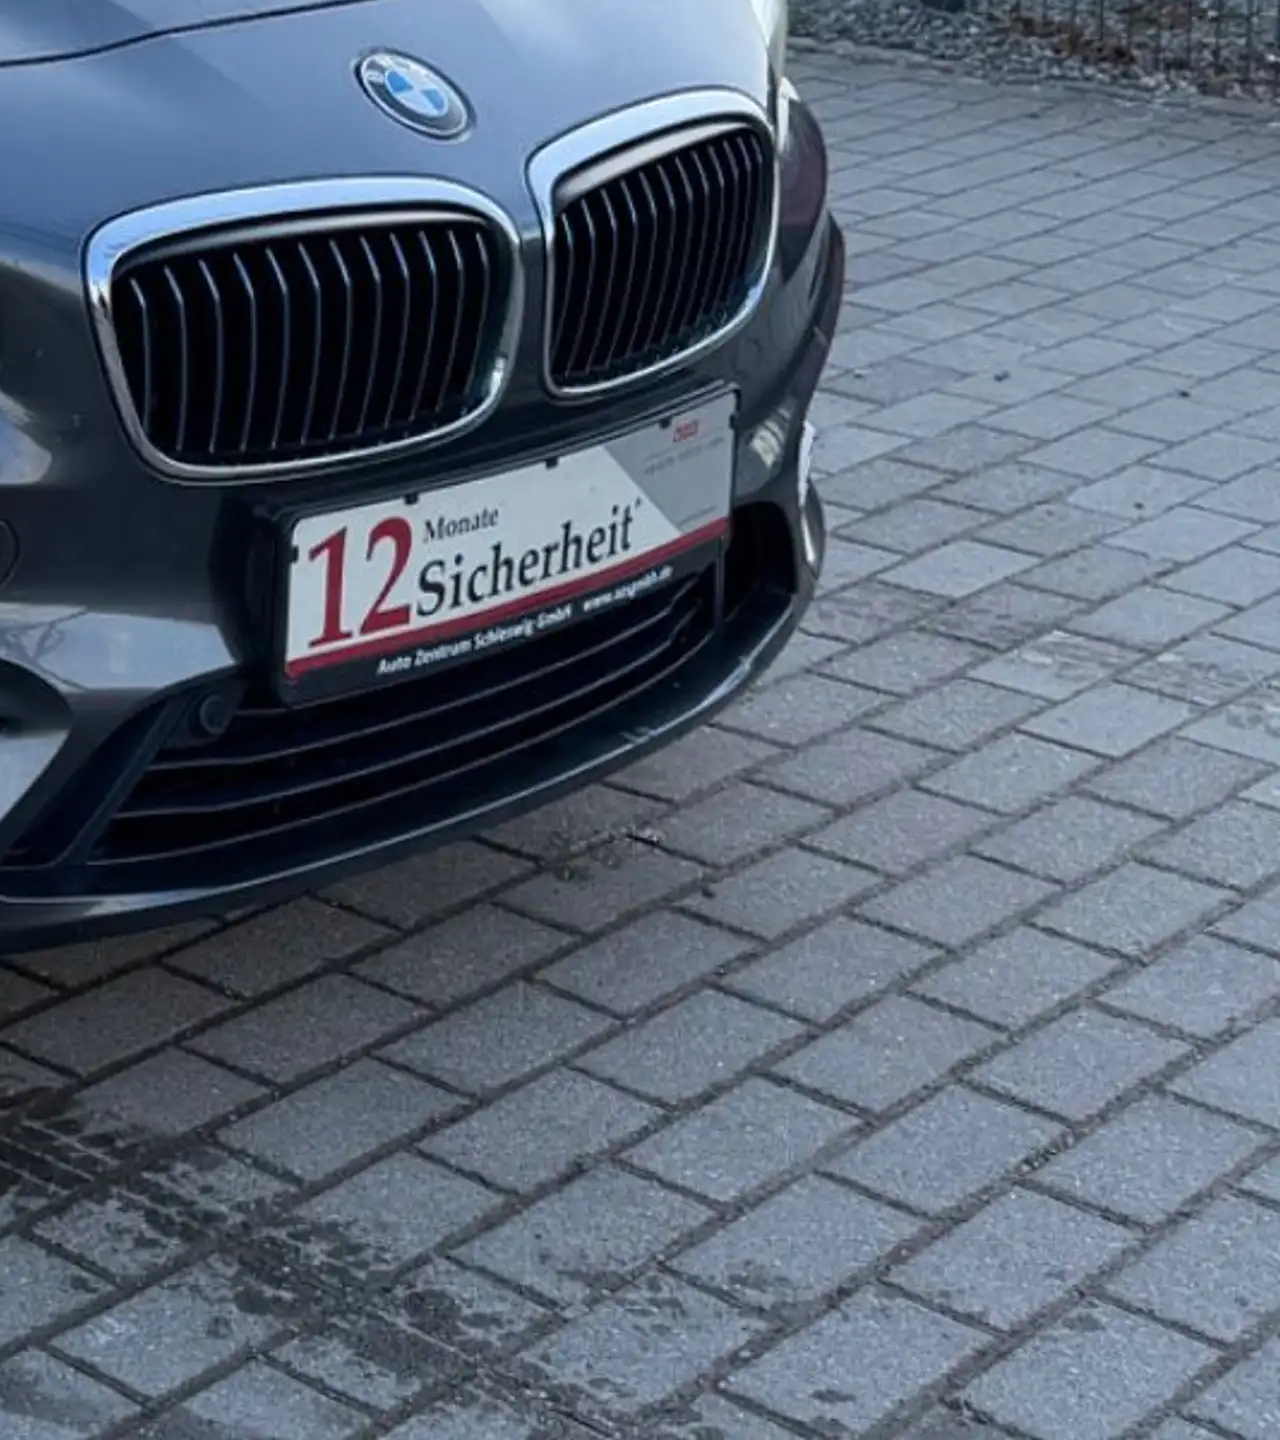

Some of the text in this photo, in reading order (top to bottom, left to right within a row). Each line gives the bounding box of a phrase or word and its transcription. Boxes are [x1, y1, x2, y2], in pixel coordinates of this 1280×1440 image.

[422, 506, 499, 544] Monate
[308, 516, 413, 649] 12
[376, 656, 412, 676] Auto
[414, 638, 472, 666] Zentrum
[473, 621, 533, 650] Schleswig
